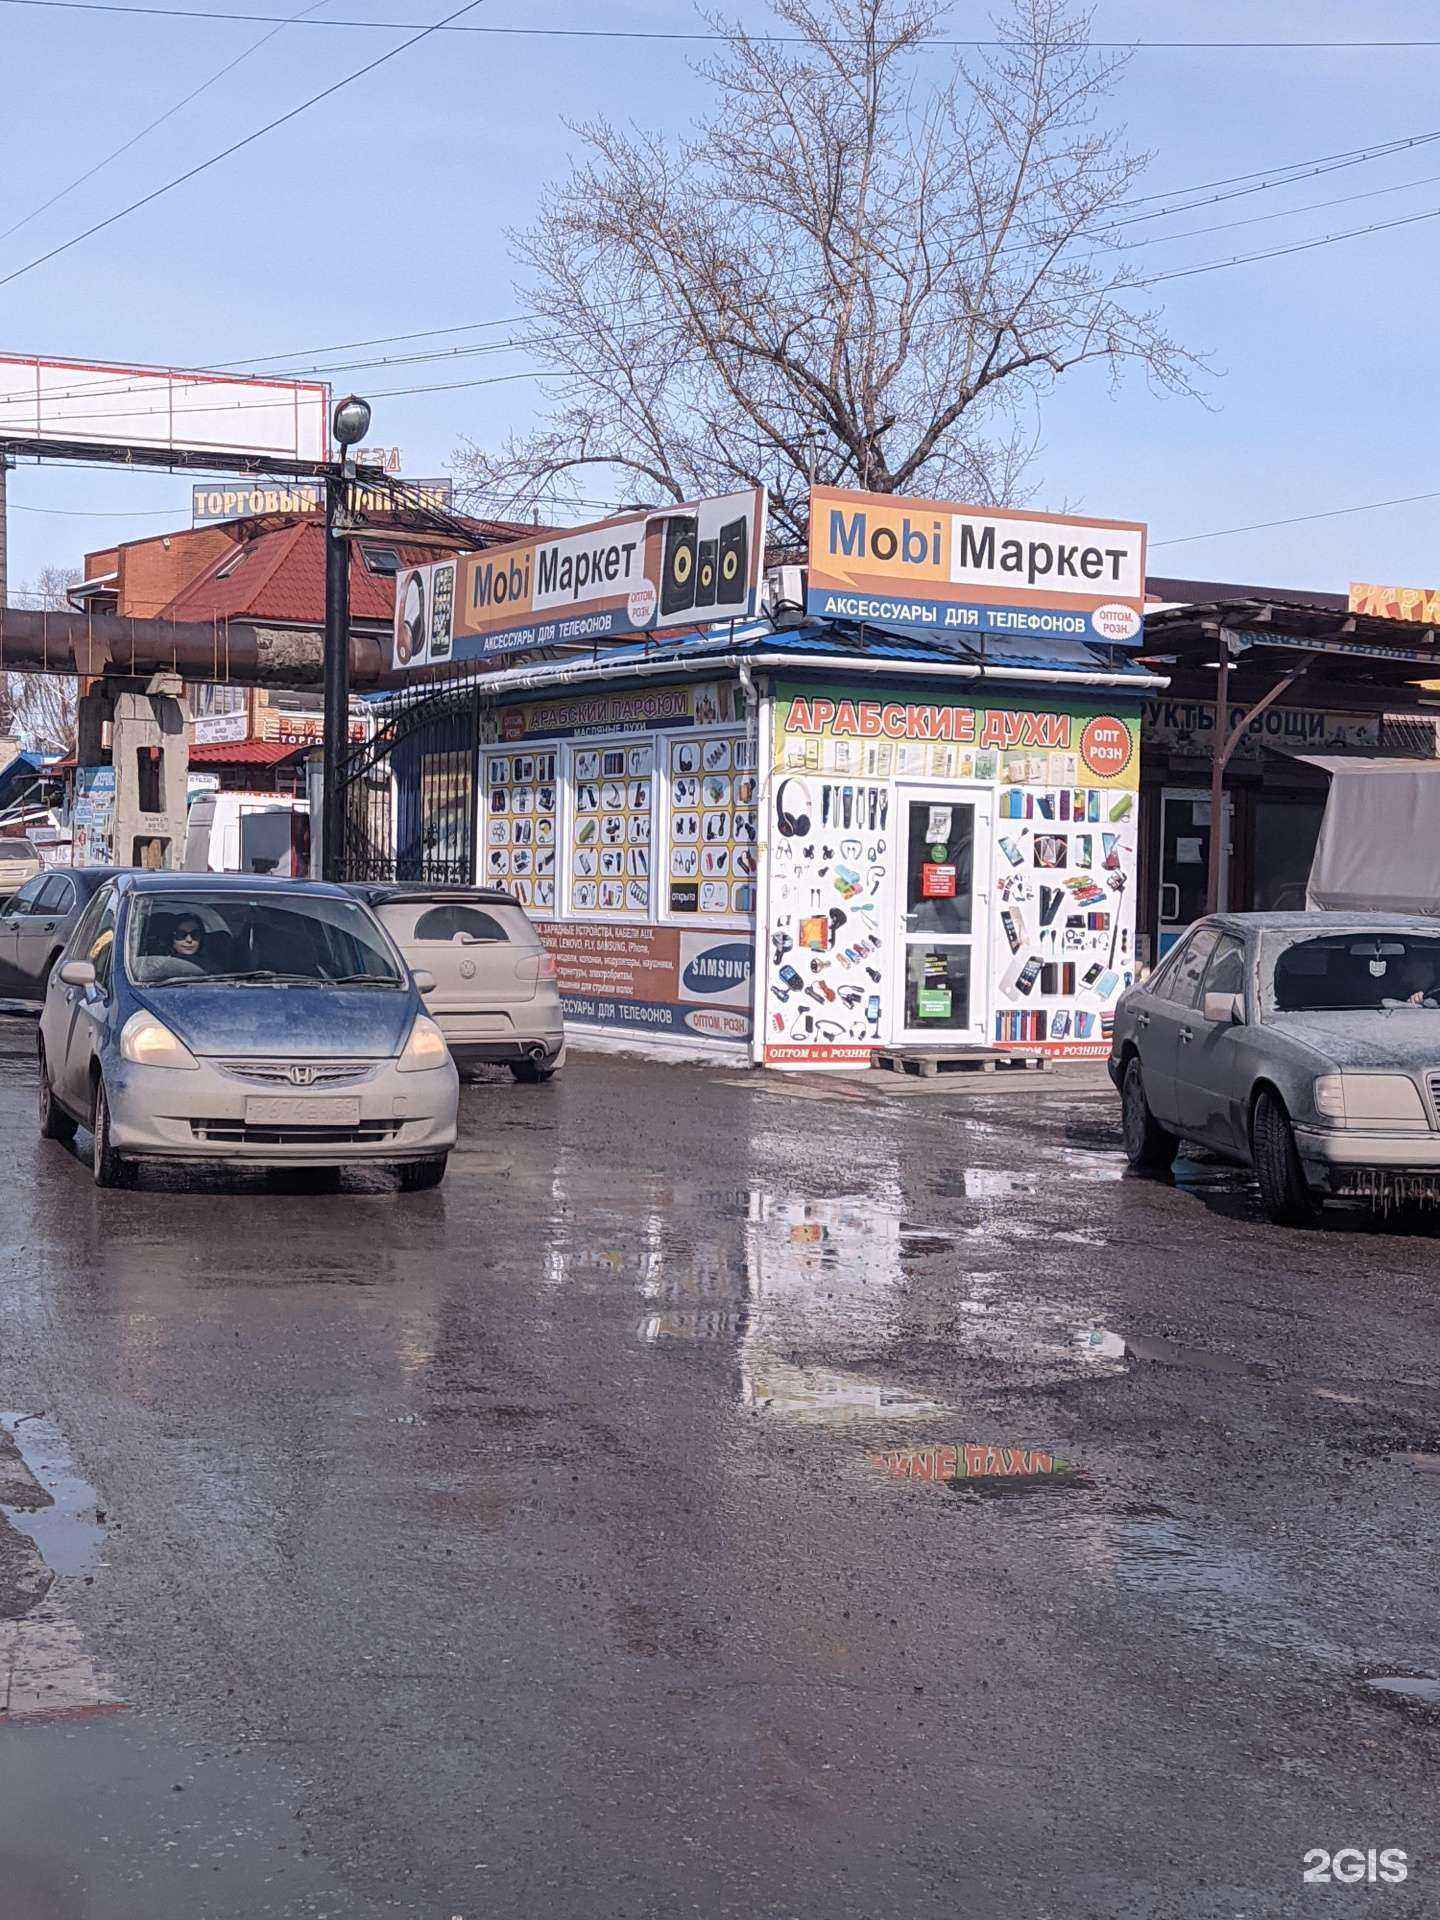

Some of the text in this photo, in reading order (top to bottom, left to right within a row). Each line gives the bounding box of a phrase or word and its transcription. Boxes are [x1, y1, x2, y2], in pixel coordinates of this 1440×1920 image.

[194, 488, 317, 515] ТОРГОВЫЙ
[830, 510, 1128, 584] Mobi Маркет
[473, 542, 637, 609] Mobi Маркет
[824, 597, 1086, 633] АКСЕССУАРЫ ДЛЯ ТЕЛЕФОНОВ
[483, 615, 612, 651] АКСЕССУАРЫ ДЛЯ ТЕЛЕФОНОВ
[529, 692, 688, 729] АРАБСКИЙ ПАРФЮМ
[784, 697, 1071, 750] АРАБСКИЕ ДУХИ
[1141, 703, 1218, 731] УКТЫ
[623, 721, 646, 733] ДУХИ
[1094, 729, 1119, 743] ОПТ
[1090, 746, 1123, 761] РОЗН
[692, 958, 751, 980] SAMSUNG
[598, 1003, 616, 1018] ДЛЯ
[619, 1005, 672, 1023] ТЕЛЕФОНОВ
[769, 1048, 809, 1058] ОПТОМ
